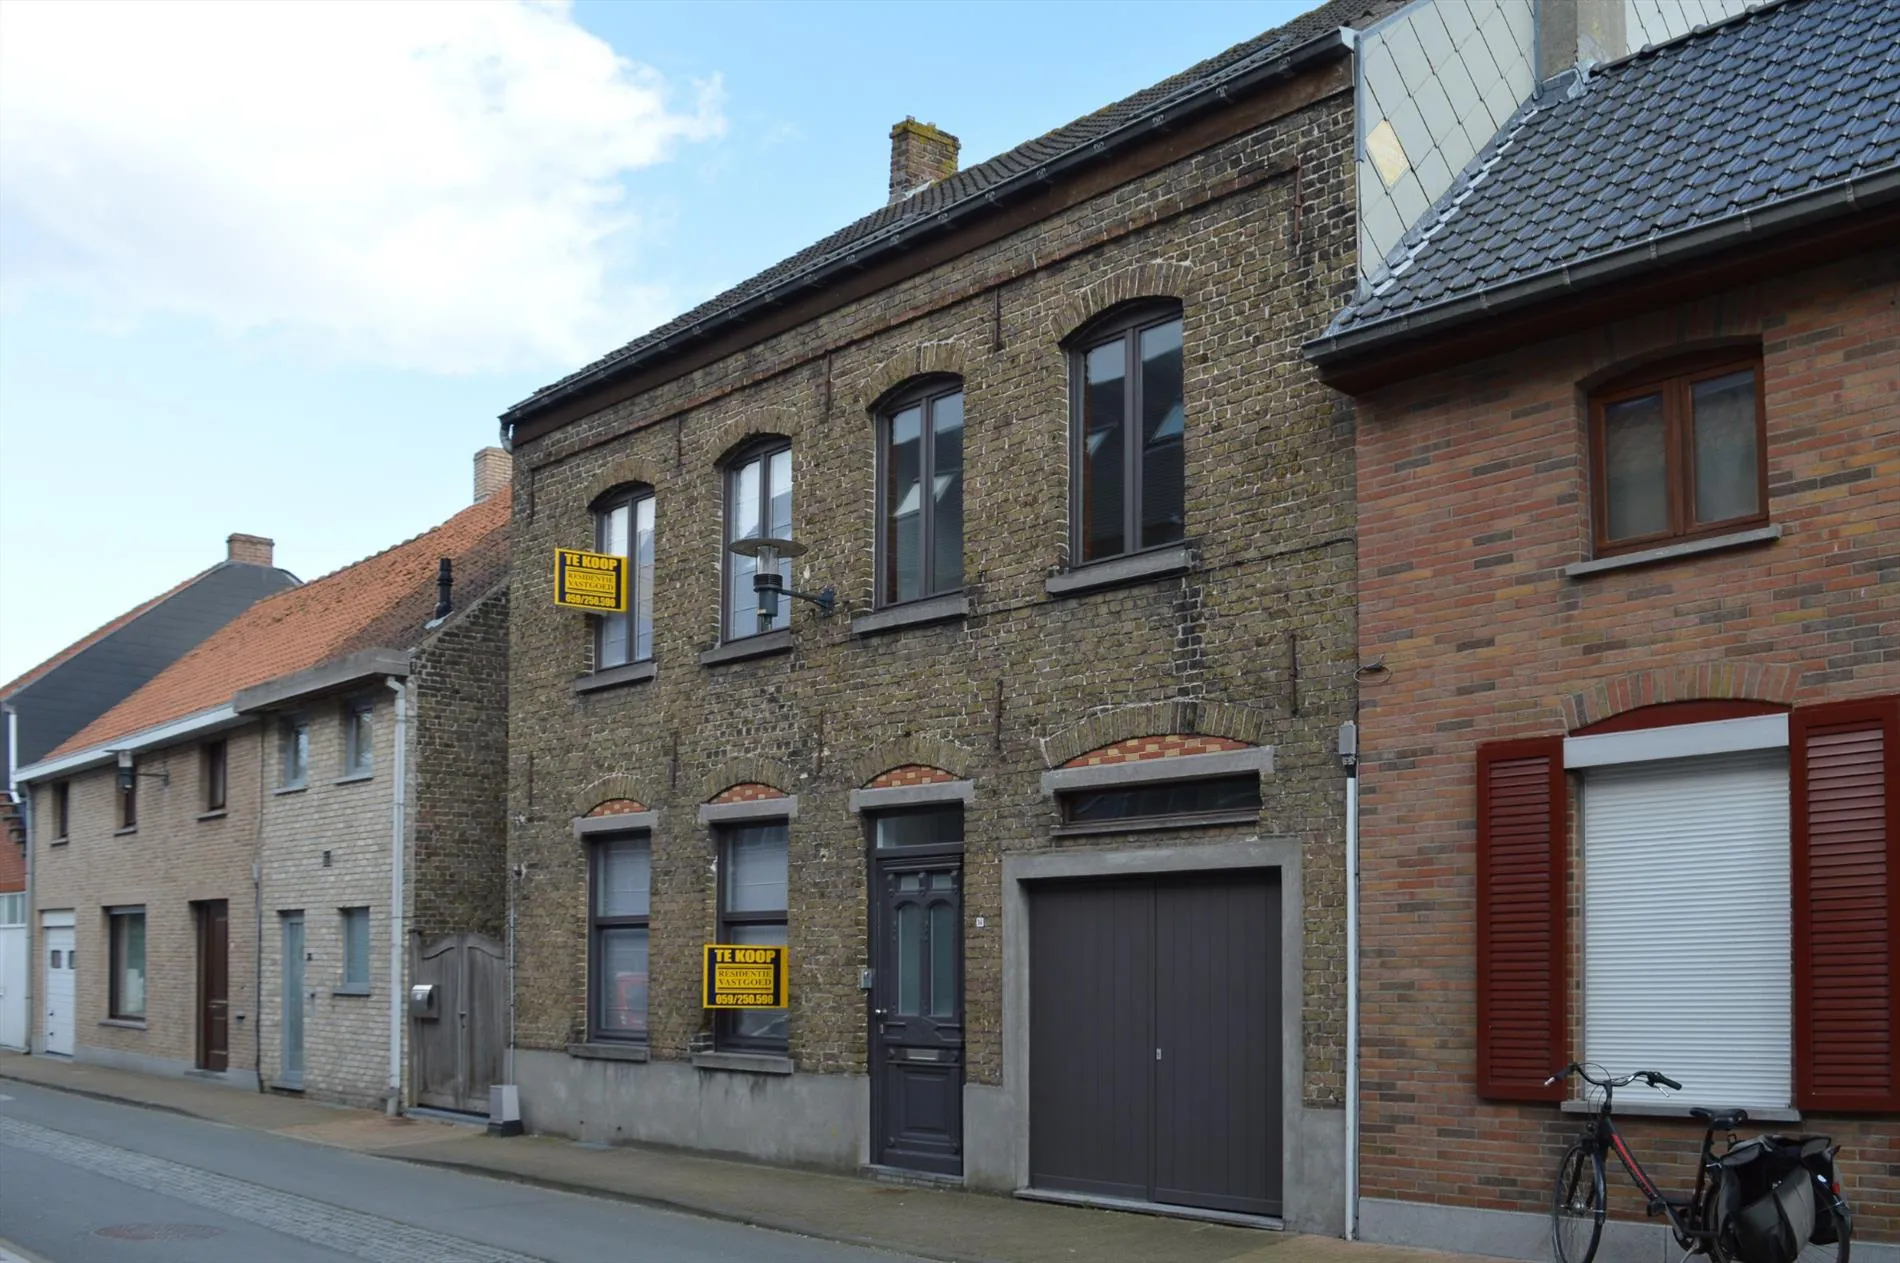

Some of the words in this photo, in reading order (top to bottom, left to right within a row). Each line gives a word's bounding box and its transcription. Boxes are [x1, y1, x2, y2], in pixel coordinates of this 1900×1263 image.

[564, 553, 580, 565] TE
[582, 556, 617, 570] KOOP
[568, 579, 614, 591] VASTGOED
[714, 949, 731, 962] TE
[735, 950, 776, 963] KOOP
[718, 970, 772, 978] RESIDENTIE
[718, 978, 772, 986] VASTGOED
